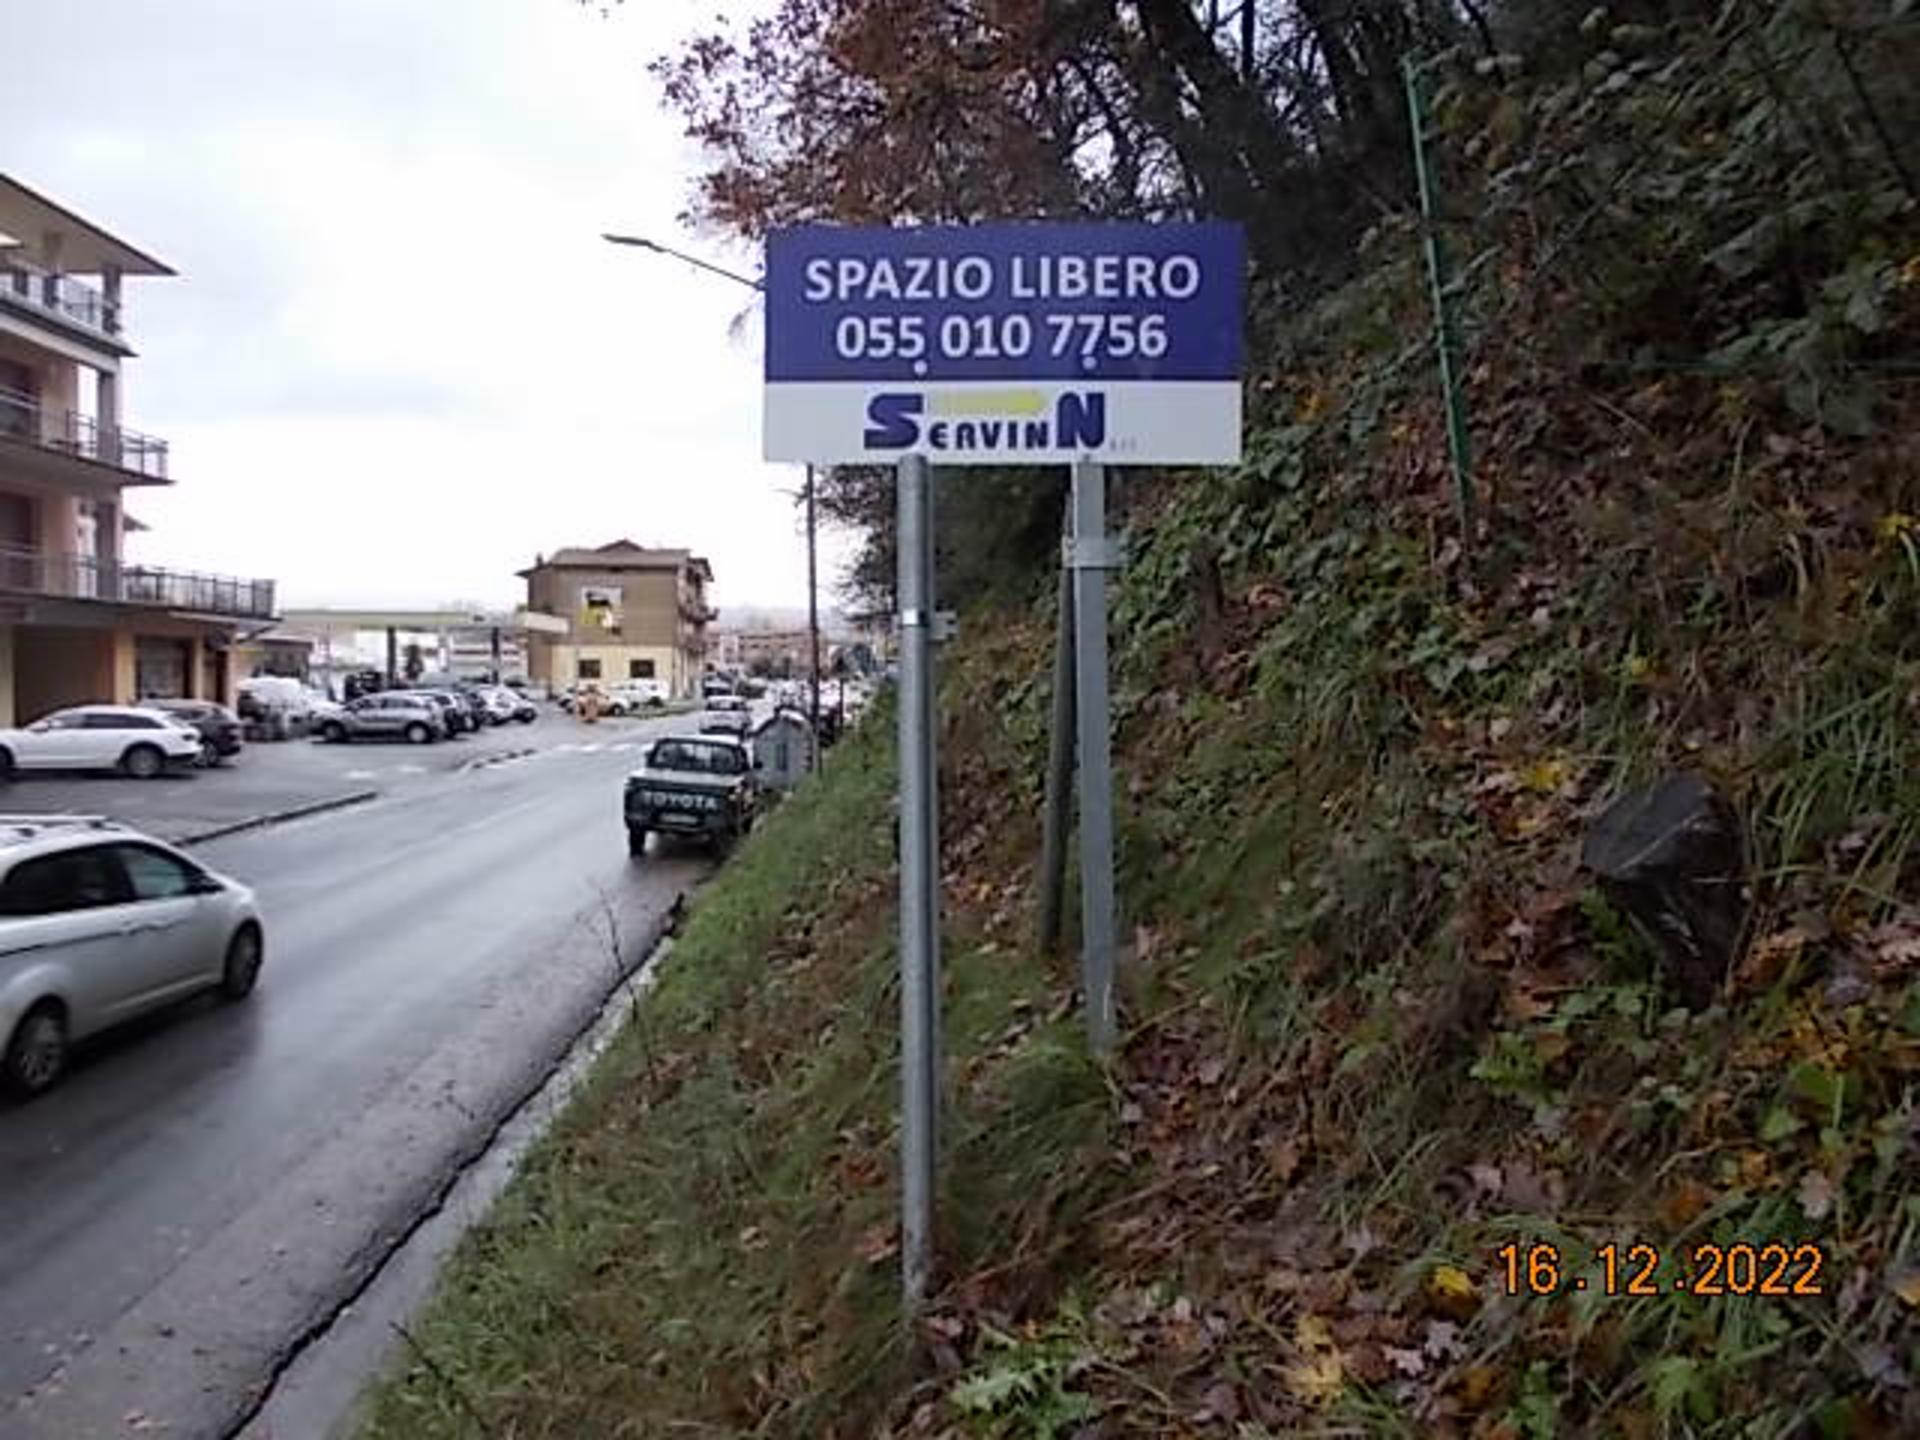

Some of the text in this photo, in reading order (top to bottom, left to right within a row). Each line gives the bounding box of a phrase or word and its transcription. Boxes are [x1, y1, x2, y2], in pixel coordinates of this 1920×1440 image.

[805, 255, 1200, 300] SPAZIO LIBERO
[836, 314, 1168, 358] 055 010 7756
[643, 791, 717, 811] TOYOTA
